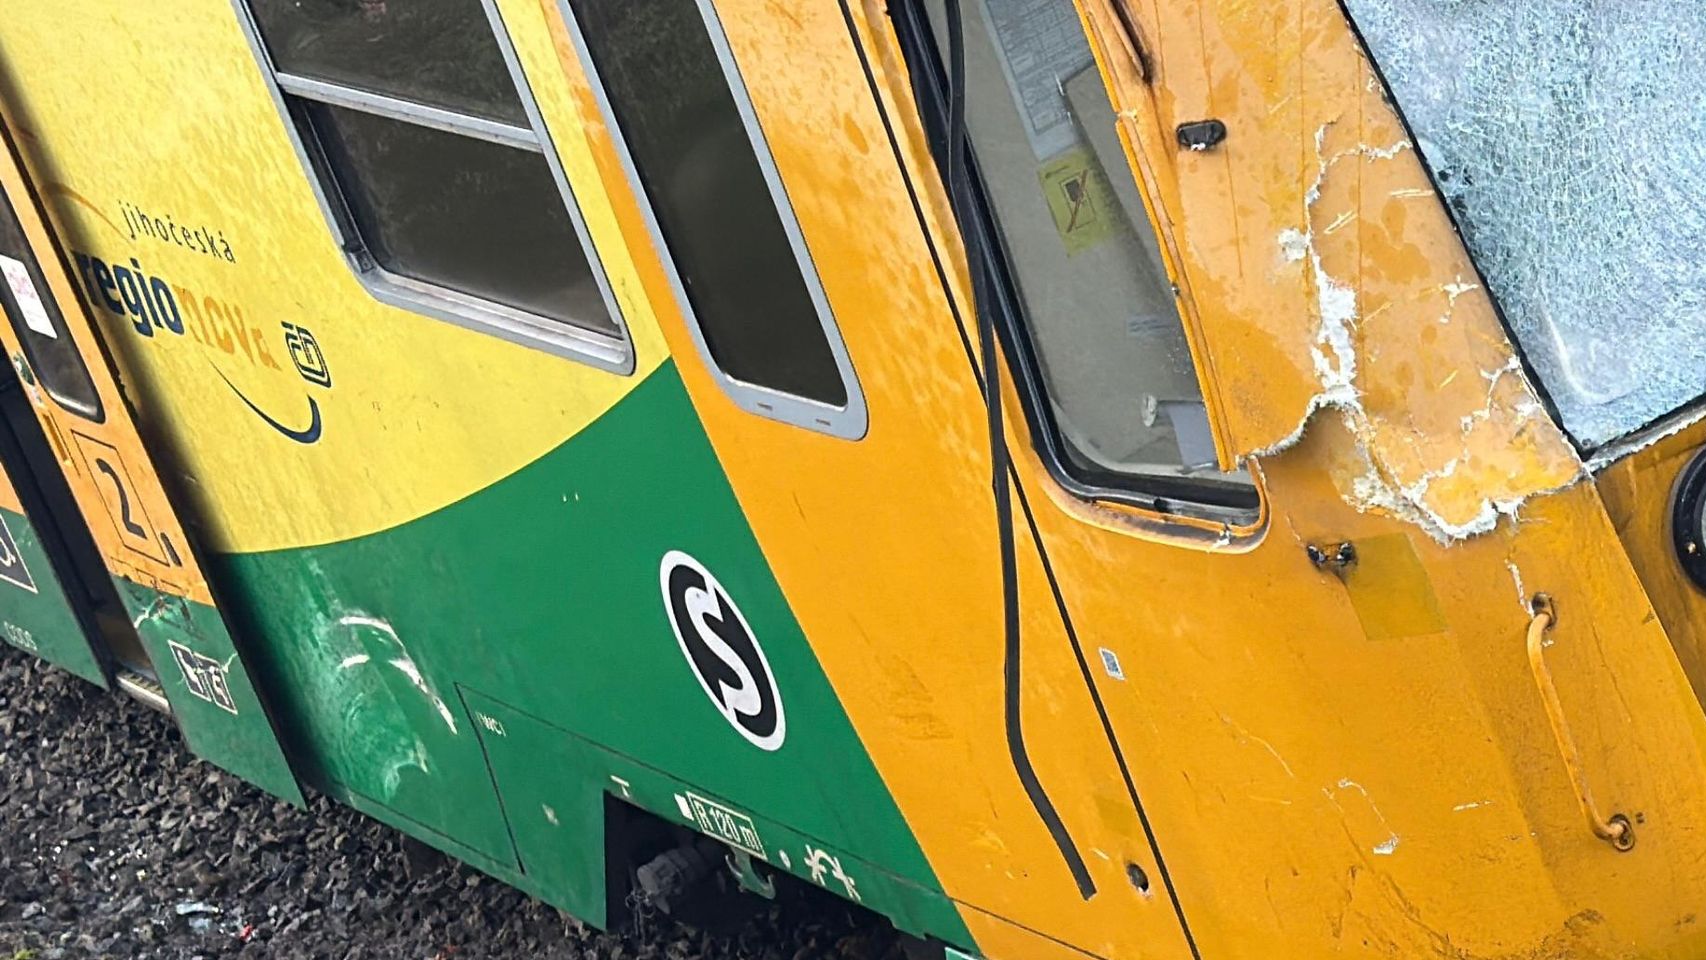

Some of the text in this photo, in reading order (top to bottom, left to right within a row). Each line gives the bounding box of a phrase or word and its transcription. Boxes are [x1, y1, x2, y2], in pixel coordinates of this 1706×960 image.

[118, 200, 236, 264] jihočeská
[693, 799, 761, 852] R 120 m
